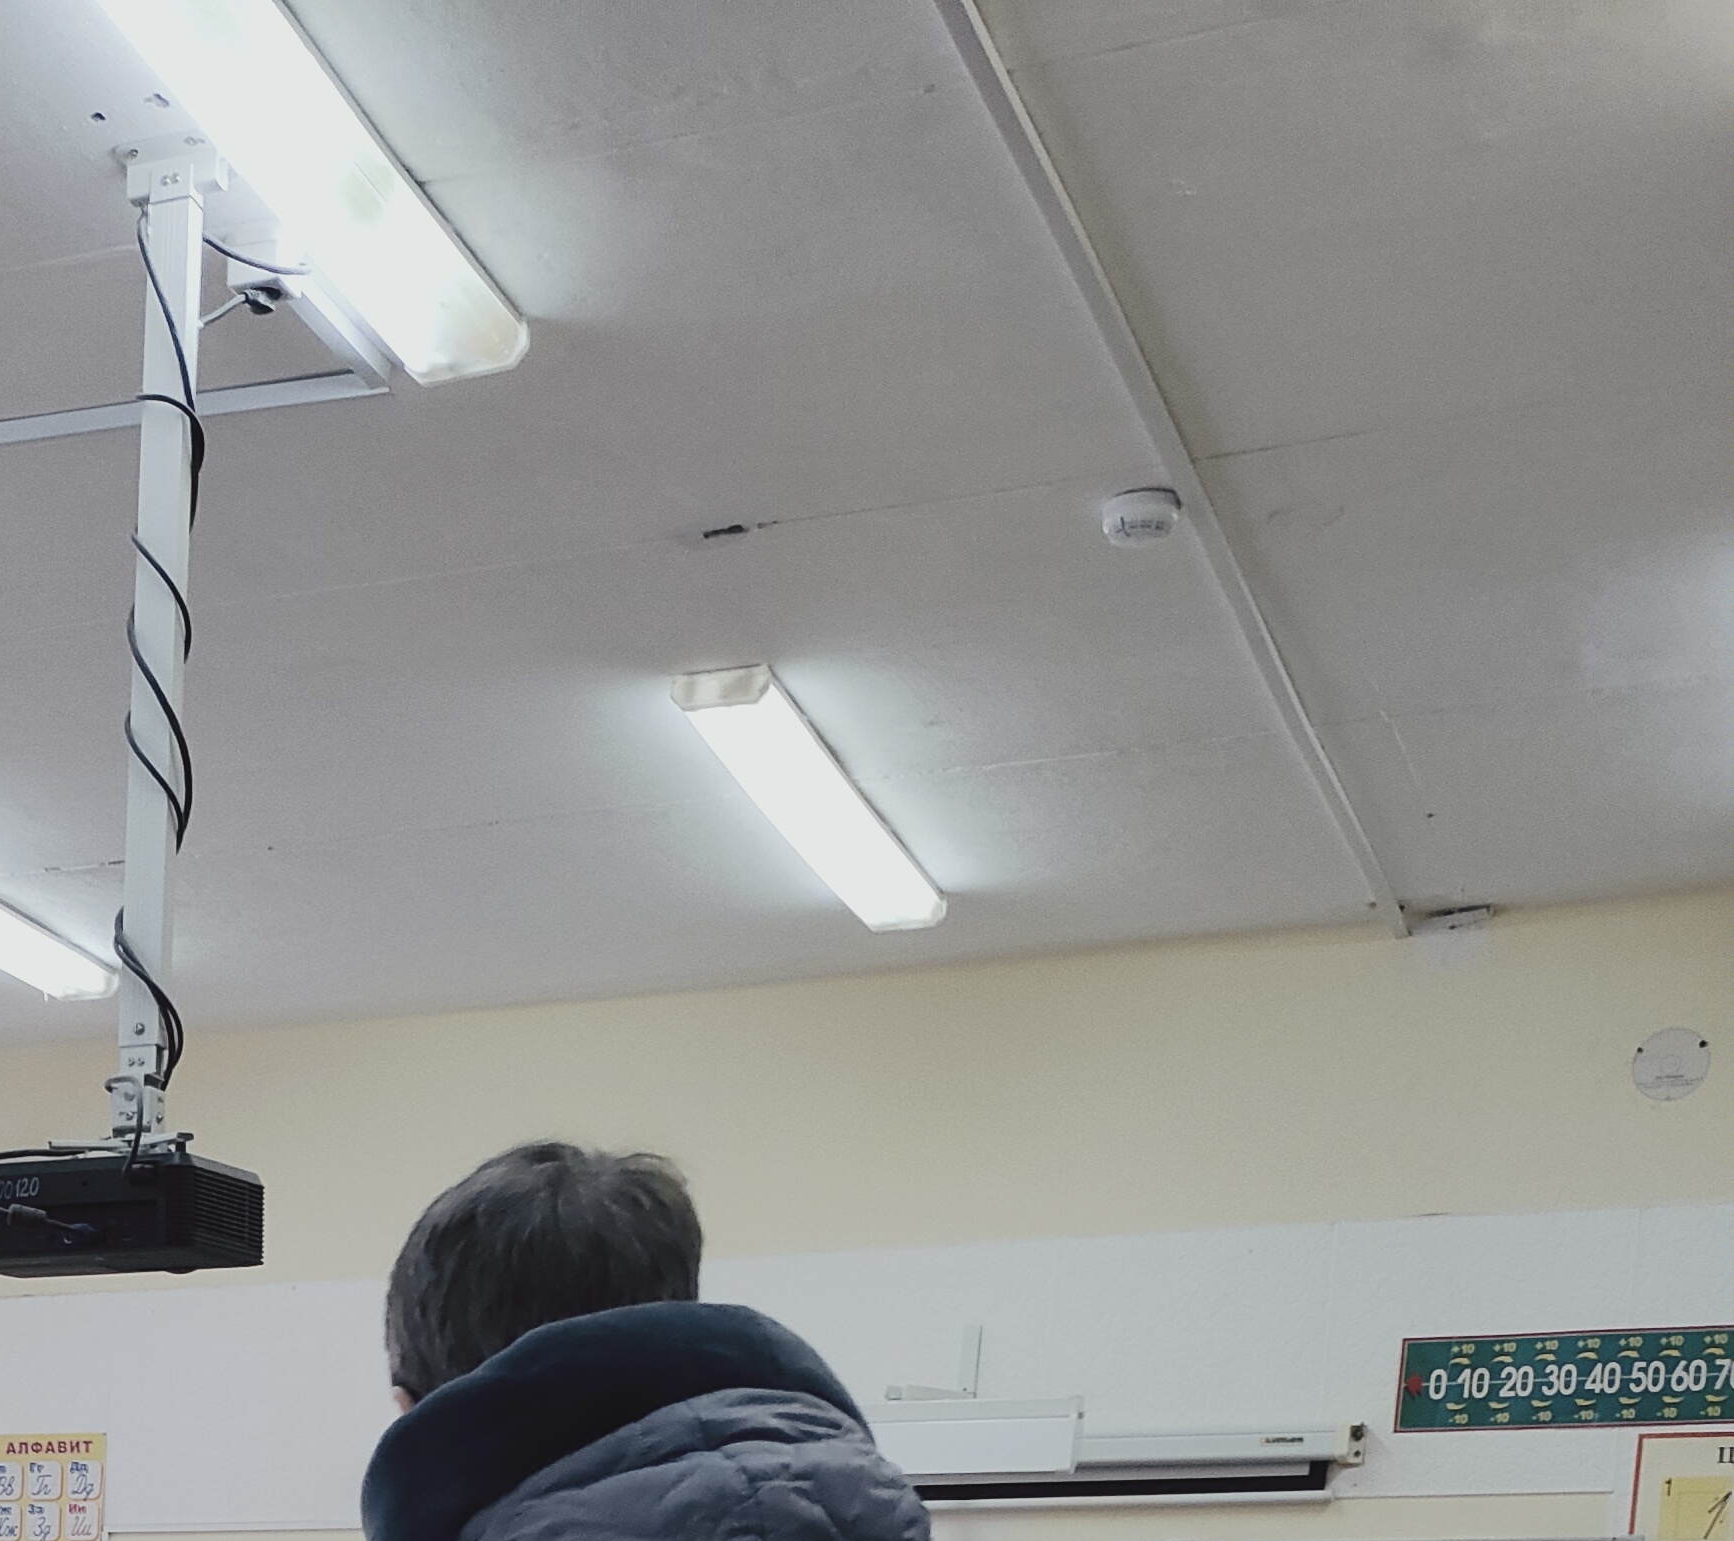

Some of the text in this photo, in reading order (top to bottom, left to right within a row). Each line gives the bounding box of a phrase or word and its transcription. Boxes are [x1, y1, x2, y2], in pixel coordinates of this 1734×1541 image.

[1429, 1359, 1734, 1400] 0 10 20 30 40 50 60 7
[6, 1441, 93, 1454] АЛФАВИТ
[1665, 1478, 1732, 1539] 1 1
